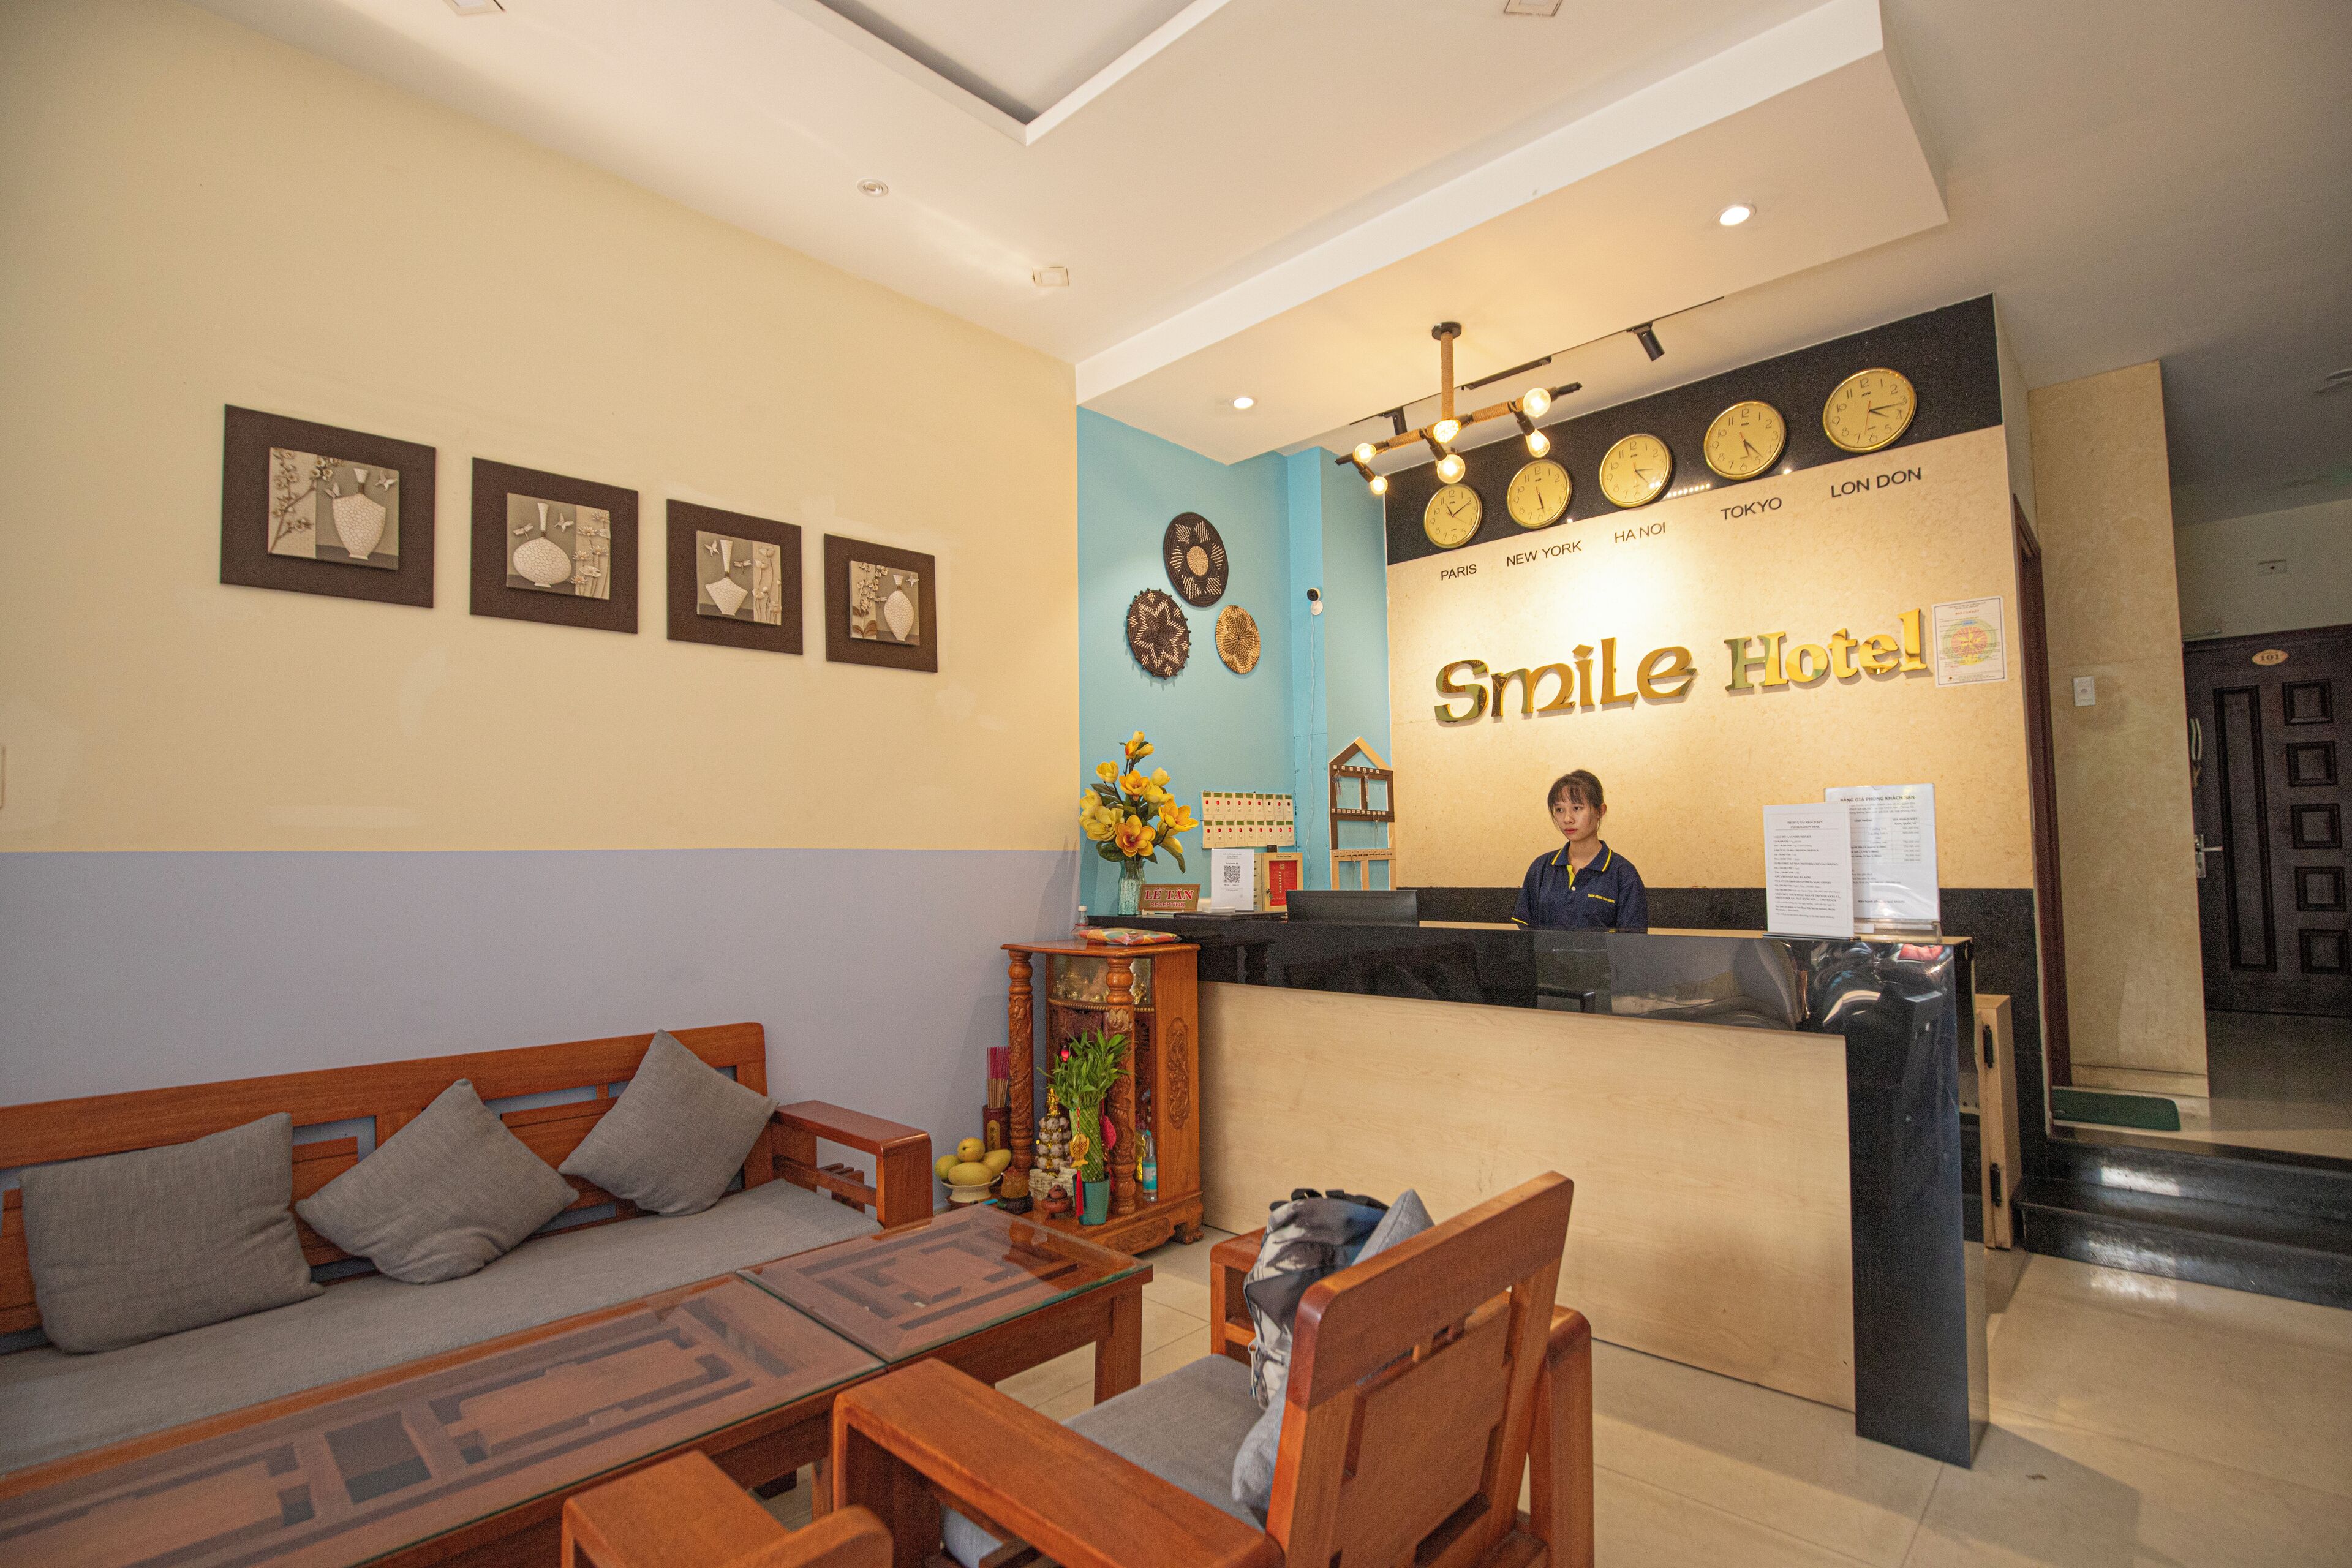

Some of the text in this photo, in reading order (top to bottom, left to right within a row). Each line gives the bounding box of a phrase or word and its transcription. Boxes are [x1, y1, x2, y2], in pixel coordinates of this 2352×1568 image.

[1831, 467, 1921, 497] LON DON
[1721, 497, 1782, 520] TOKYO
[1615, 522, 1665, 543] HA NOI
[1507, 540, 1581, 567] NEW YORK
[1441, 564, 1477, 581] PARIS
[1724, 608, 1927, 692] Hotel
[1144, 887, 1195, 900] LỄ TÂN
